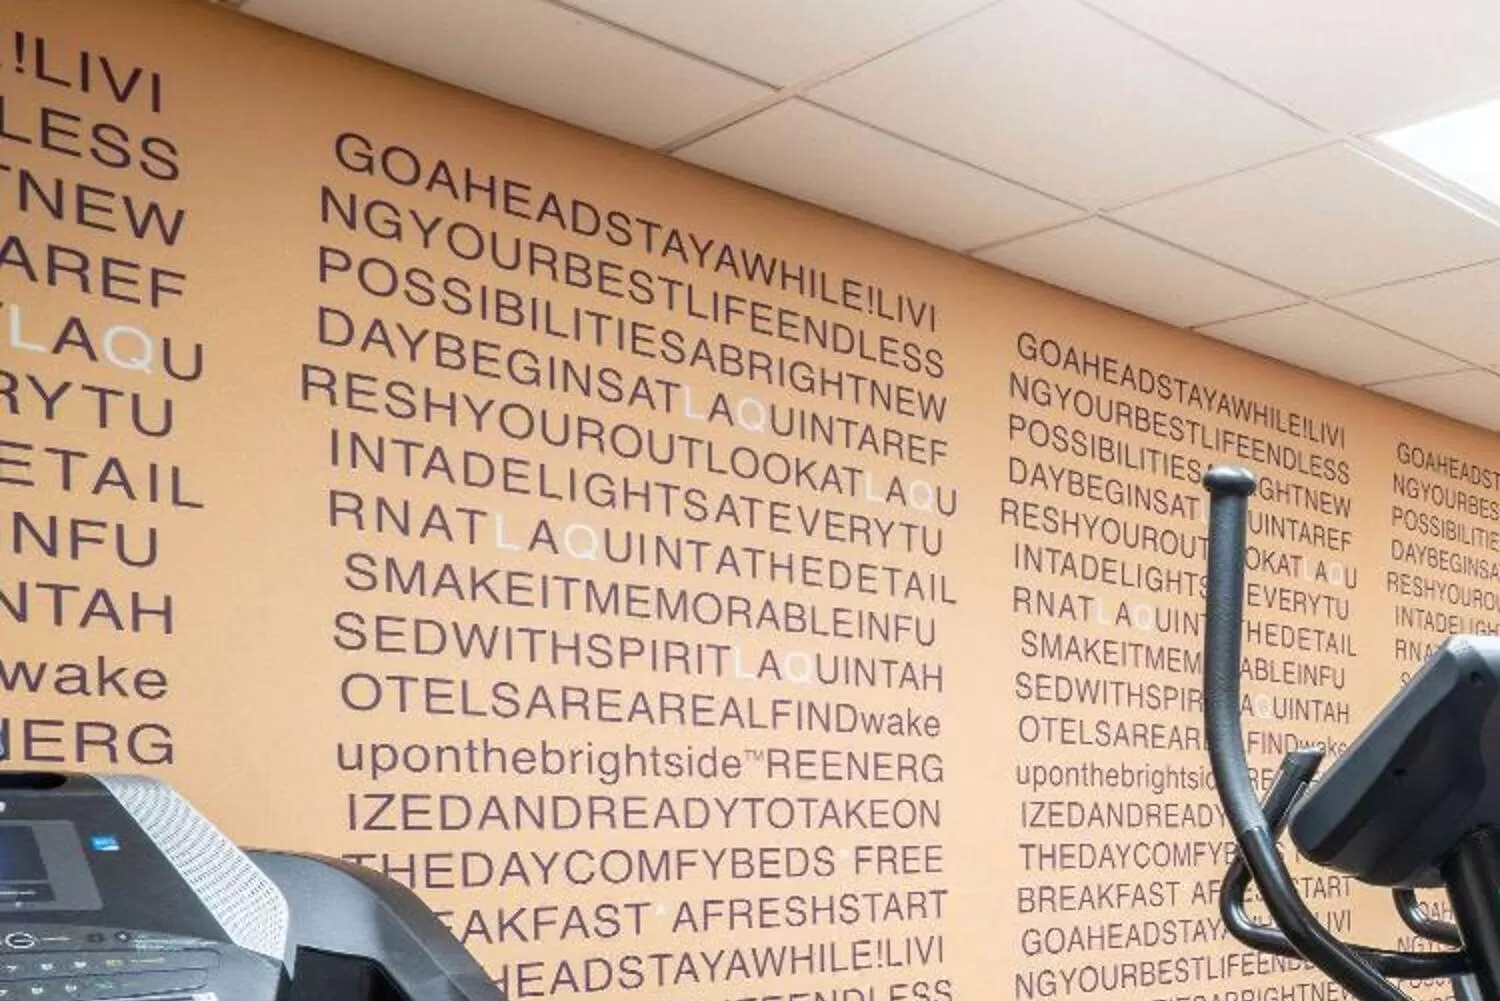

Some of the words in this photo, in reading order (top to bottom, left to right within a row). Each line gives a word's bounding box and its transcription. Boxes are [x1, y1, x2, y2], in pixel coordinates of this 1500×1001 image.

[0, 163, 186, 247] NEW
[334, 132, 937, 333] GOAHEADSTAYAWHILE!LIVI
[319, 184, 945, 380] NGYOURBESTLIFEENDLESS
[317, 245, 947, 424] POSSIBILITIESABRIGHTNEW
[316, 305, 948, 467] DAYBEGINSATLAQUINTAREF
[1009, 371, 1351, 485] NGYOURBESTLIFEENDLESS
[300, 362, 958, 518] RESHYOUROUTLOOKATLAQU
[1009, 413, 1352, 519] POSSIBILITIESGHTNEW
[329, 428, 944, 557] INTADELIGHTSATEVERYTU
[328, 489, 957, 604] RNATLAQUINTATHEDETAIL
[344, 552, 936, 646] SMAKEITMEMORABLEINFU
[333, 611, 944, 692] SEDWITHSPIRITLAQUINTAH
[1021, 629, 1345, 691] SMAKEITMEMABLEINFU
[340, 671, 941, 738] OTELSAREAREALFINDwake
[347, 791, 942, 831] IZEDANDREADYTOTAKEON
[854, 845, 944, 876] FREE
[1018, 881, 1181, 914] BREAKFAST
[434, 901, 652, 946] AKFAST
[672, 889, 947, 935] AFRESHSTART
[493, 934, 945, 1000] HEADSTAYAWHILE!LIVI
